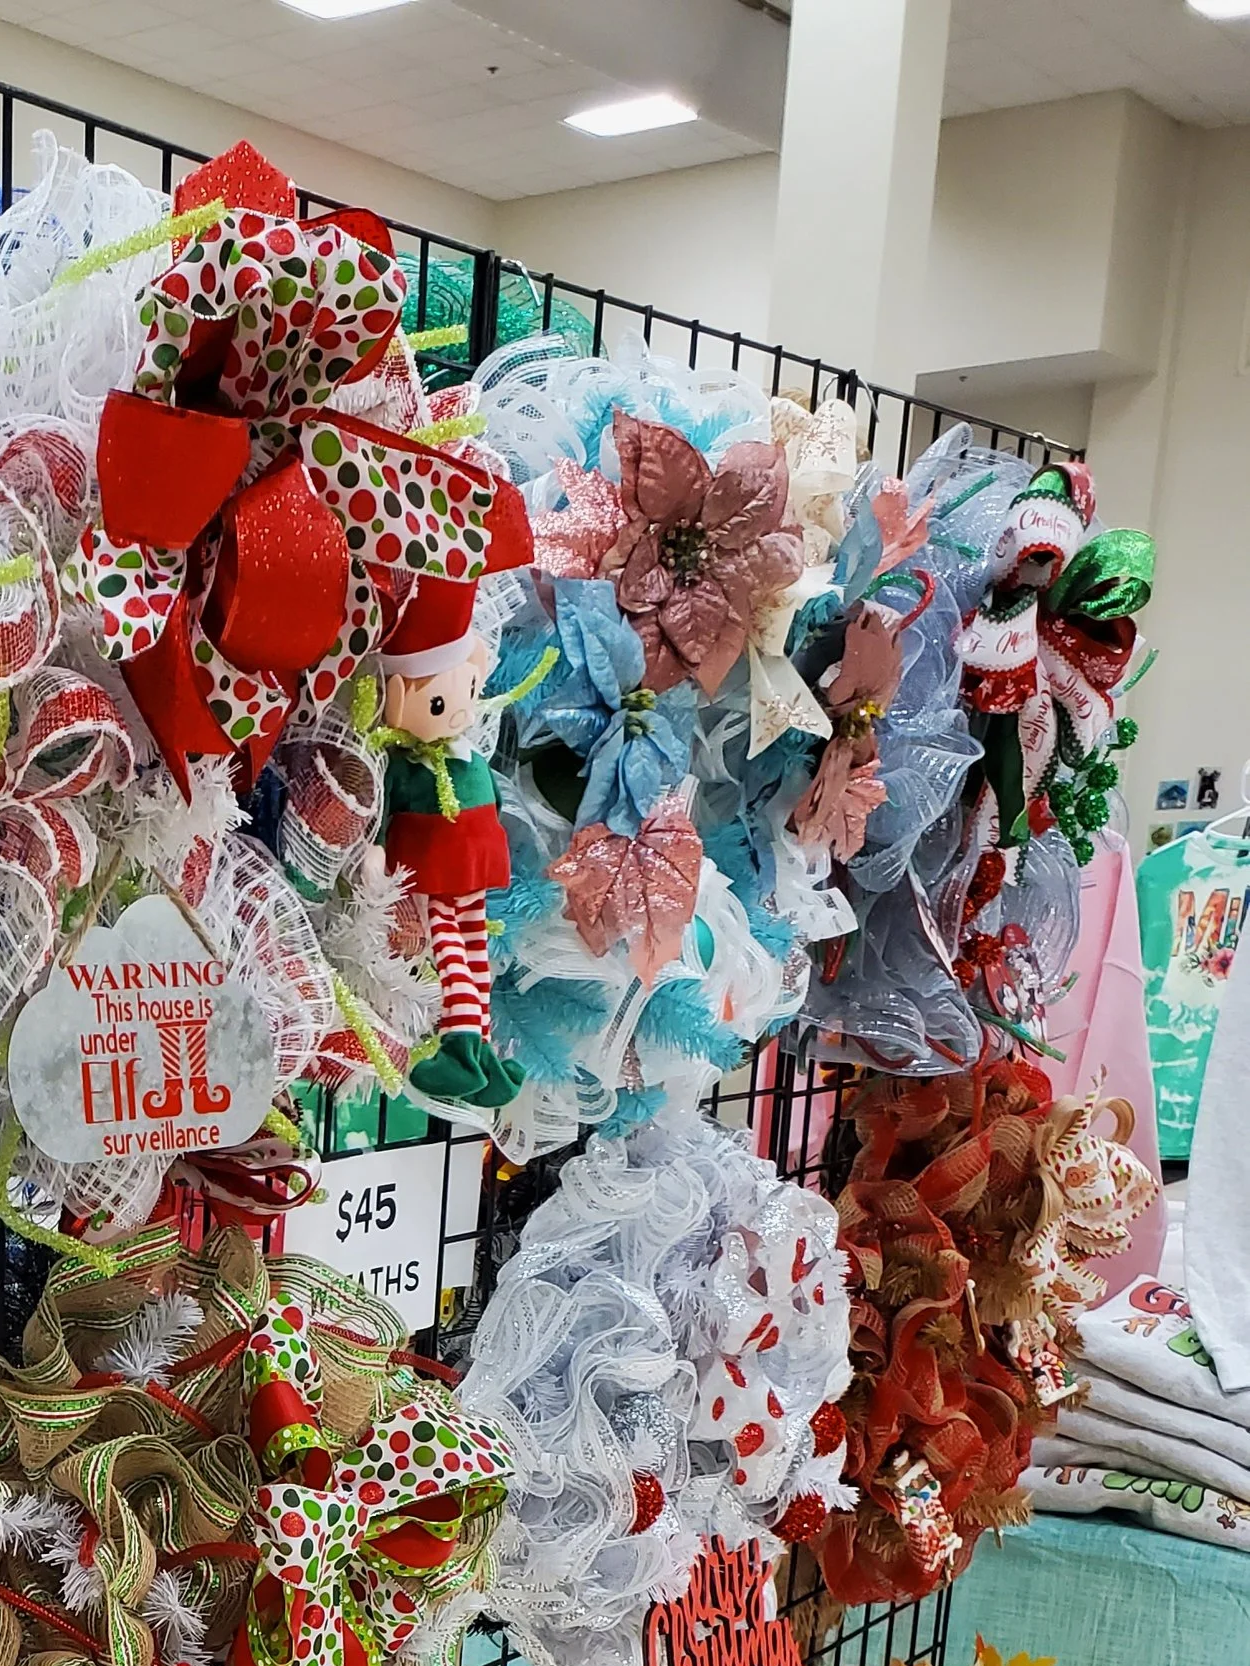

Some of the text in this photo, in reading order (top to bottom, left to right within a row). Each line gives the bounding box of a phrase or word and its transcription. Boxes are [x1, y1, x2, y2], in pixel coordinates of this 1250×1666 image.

[65, 960, 226, 992] WARNING
[91, 992, 214, 1024] This house is
[80, 1024, 138, 1055] under
[81, 1058, 143, 1124] Elf
[103, 1120, 220, 1156] surveillance
[336, 1183, 397, 1243] $45
